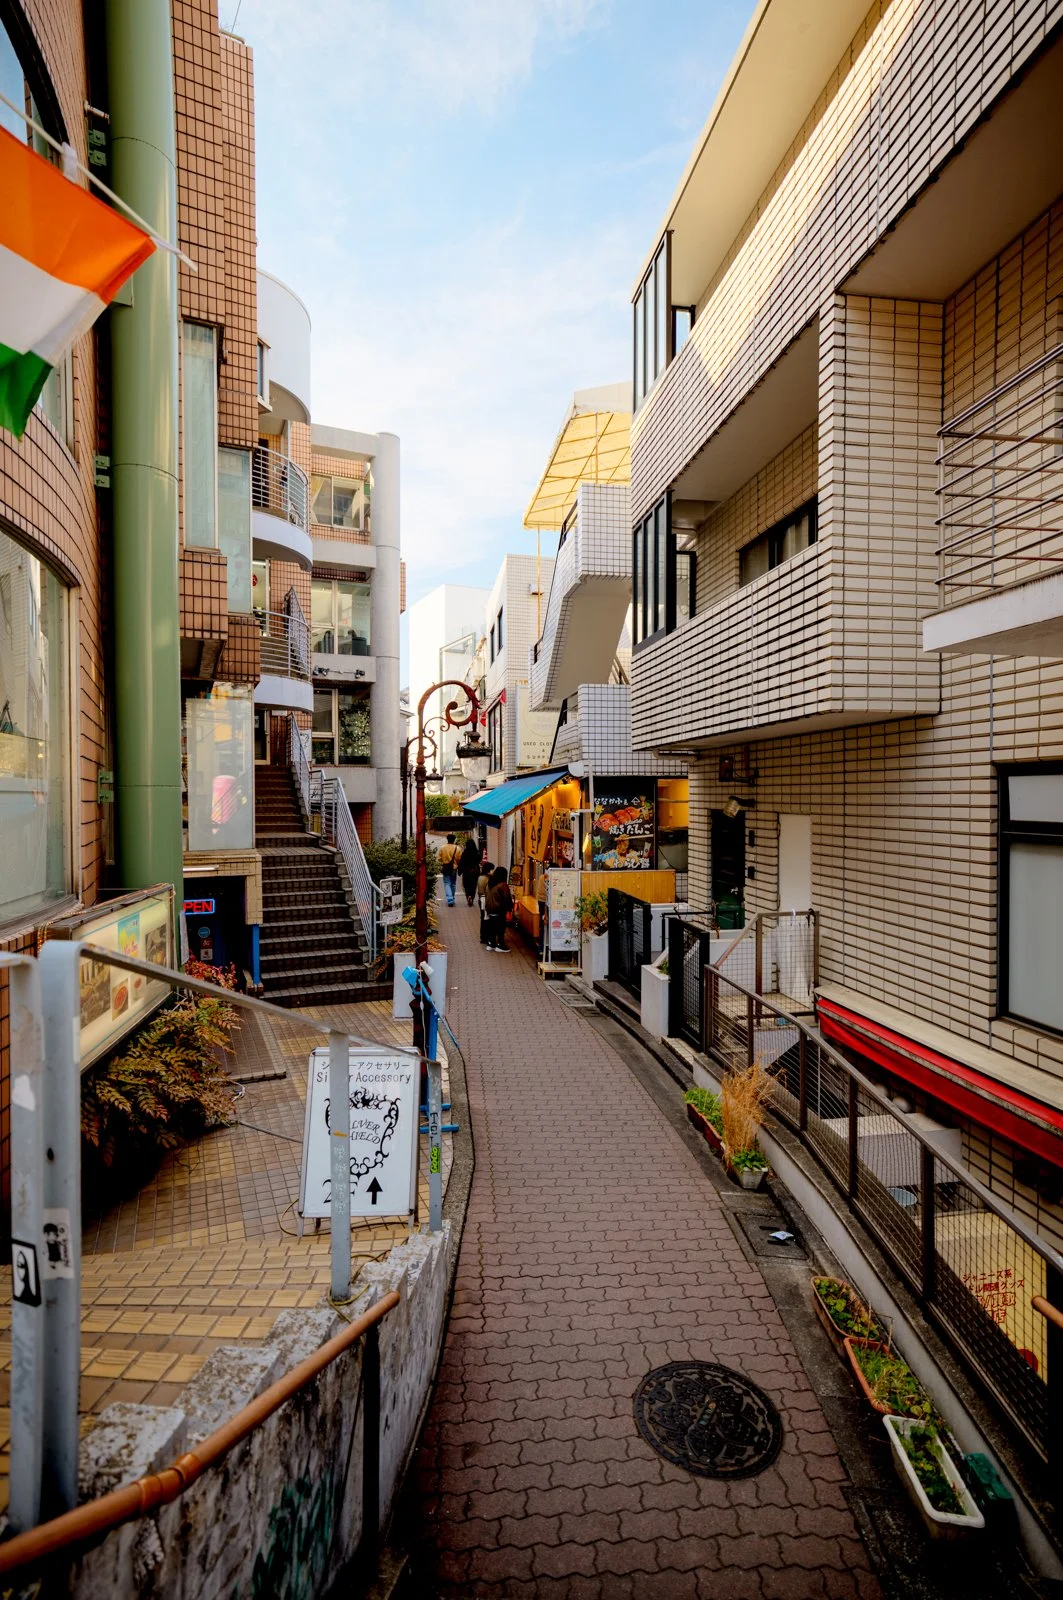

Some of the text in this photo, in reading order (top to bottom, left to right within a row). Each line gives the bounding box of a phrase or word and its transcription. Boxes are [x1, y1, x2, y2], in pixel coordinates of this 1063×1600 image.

[183, 901, 213, 912] PEN
[322, 1061, 410, 1071] シーアクセサリー
[356, 1071, 412, 1084] Accessory
[352, 1118, 380, 1135] LVER
